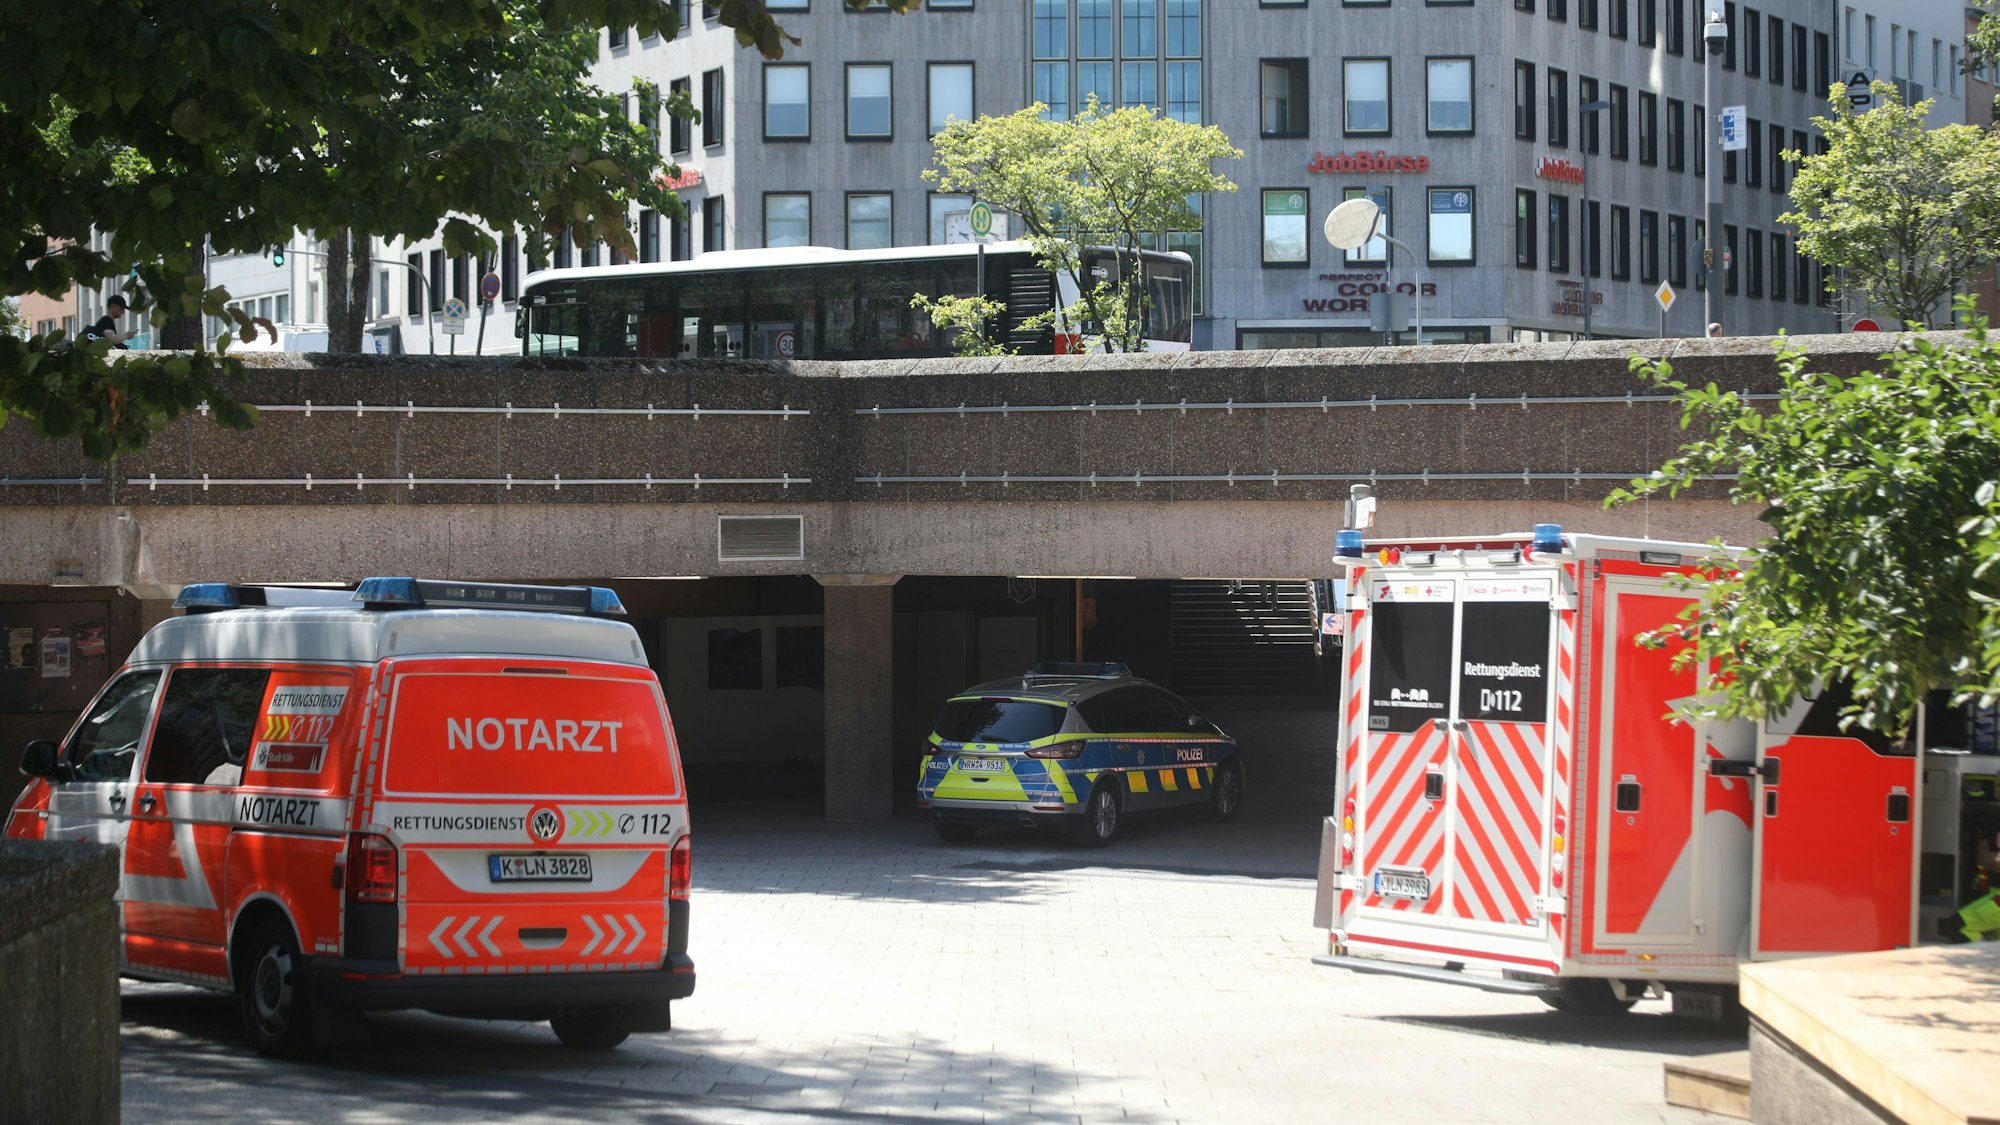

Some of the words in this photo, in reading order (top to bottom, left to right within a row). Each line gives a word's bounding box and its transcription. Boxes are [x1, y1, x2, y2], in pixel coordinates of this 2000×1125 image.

[1307, 150, 1430, 174] JobBörse
[1319, 273, 1384, 281] PERFECT
[1563, 289, 1604, 304] COOR
[1303, 299, 1369, 312] WOR
[781, 339, 794, 351] 30
[1464, 661, 1541, 680] Rettungsdienst
[271, 693, 345, 707] RETTUNGSDIENST
[1495, 689, 1523, 712] 112
[305, 715, 335, 743] 112
[1372, 718, 1386, 726] WAS
[447, 717, 623, 752] NOTARZT
[1176, 748, 1204, 761] POLIZEI
[926, 761, 948, 769] POLIZEI
[962, 760, 976, 769] NRW
[240, 797, 320, 826] NOTARZT
[393, 815, 526, 831] RETTUNGSDIENST
[640, 814, 672, 836] 112
[501, 861, 514, 877] K
[524, 860, 547, 876] LN
[549, 858, 589, 876] 3828
